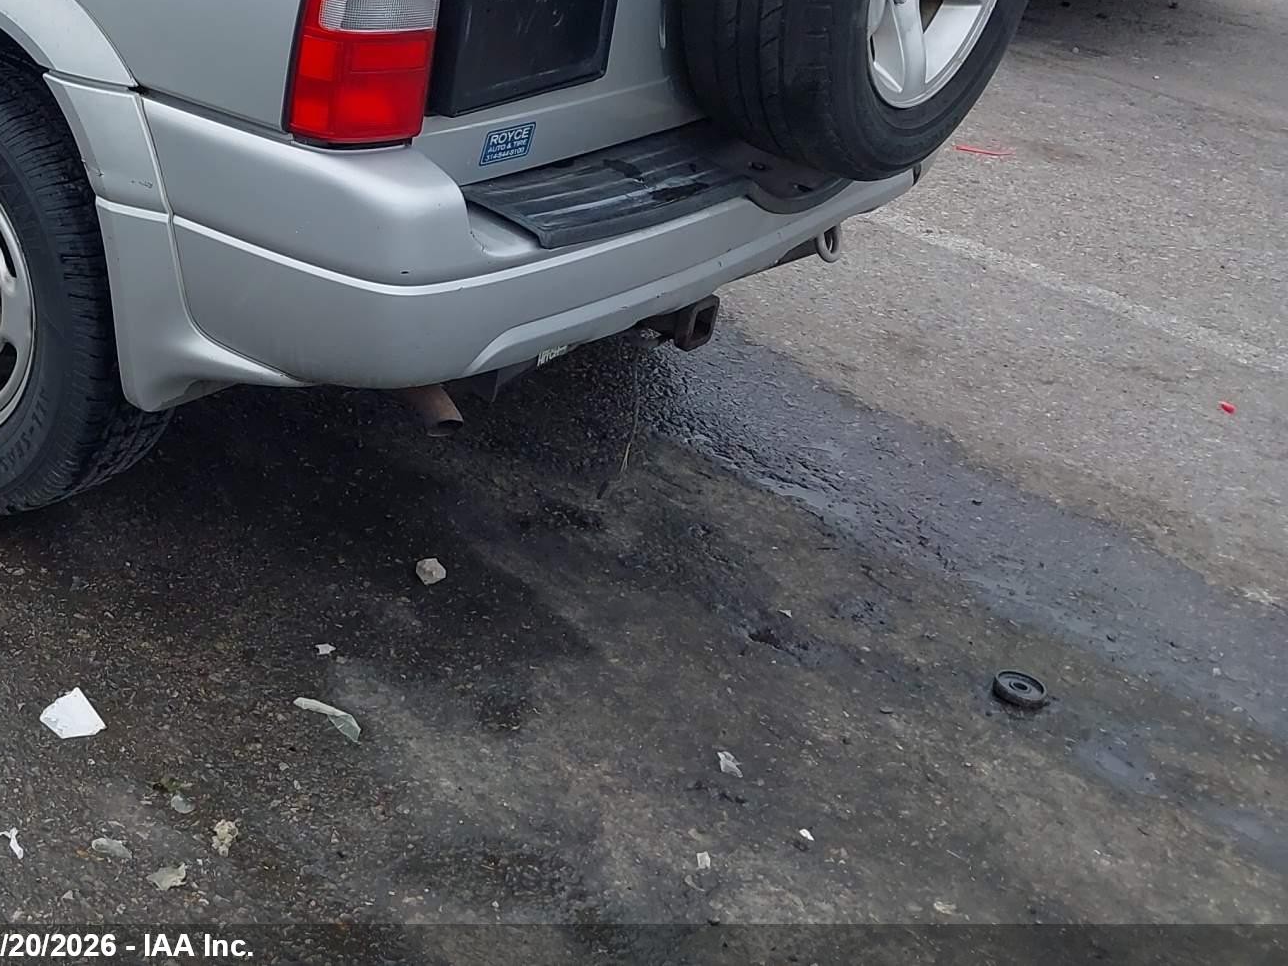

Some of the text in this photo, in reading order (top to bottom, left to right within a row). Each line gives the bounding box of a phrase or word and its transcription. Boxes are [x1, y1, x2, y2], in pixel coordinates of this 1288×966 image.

[490, 127, 530, 145] ROYCE
[488, 144, 506, 153] AUTO
[513, 138, 528, 147] TIRE
